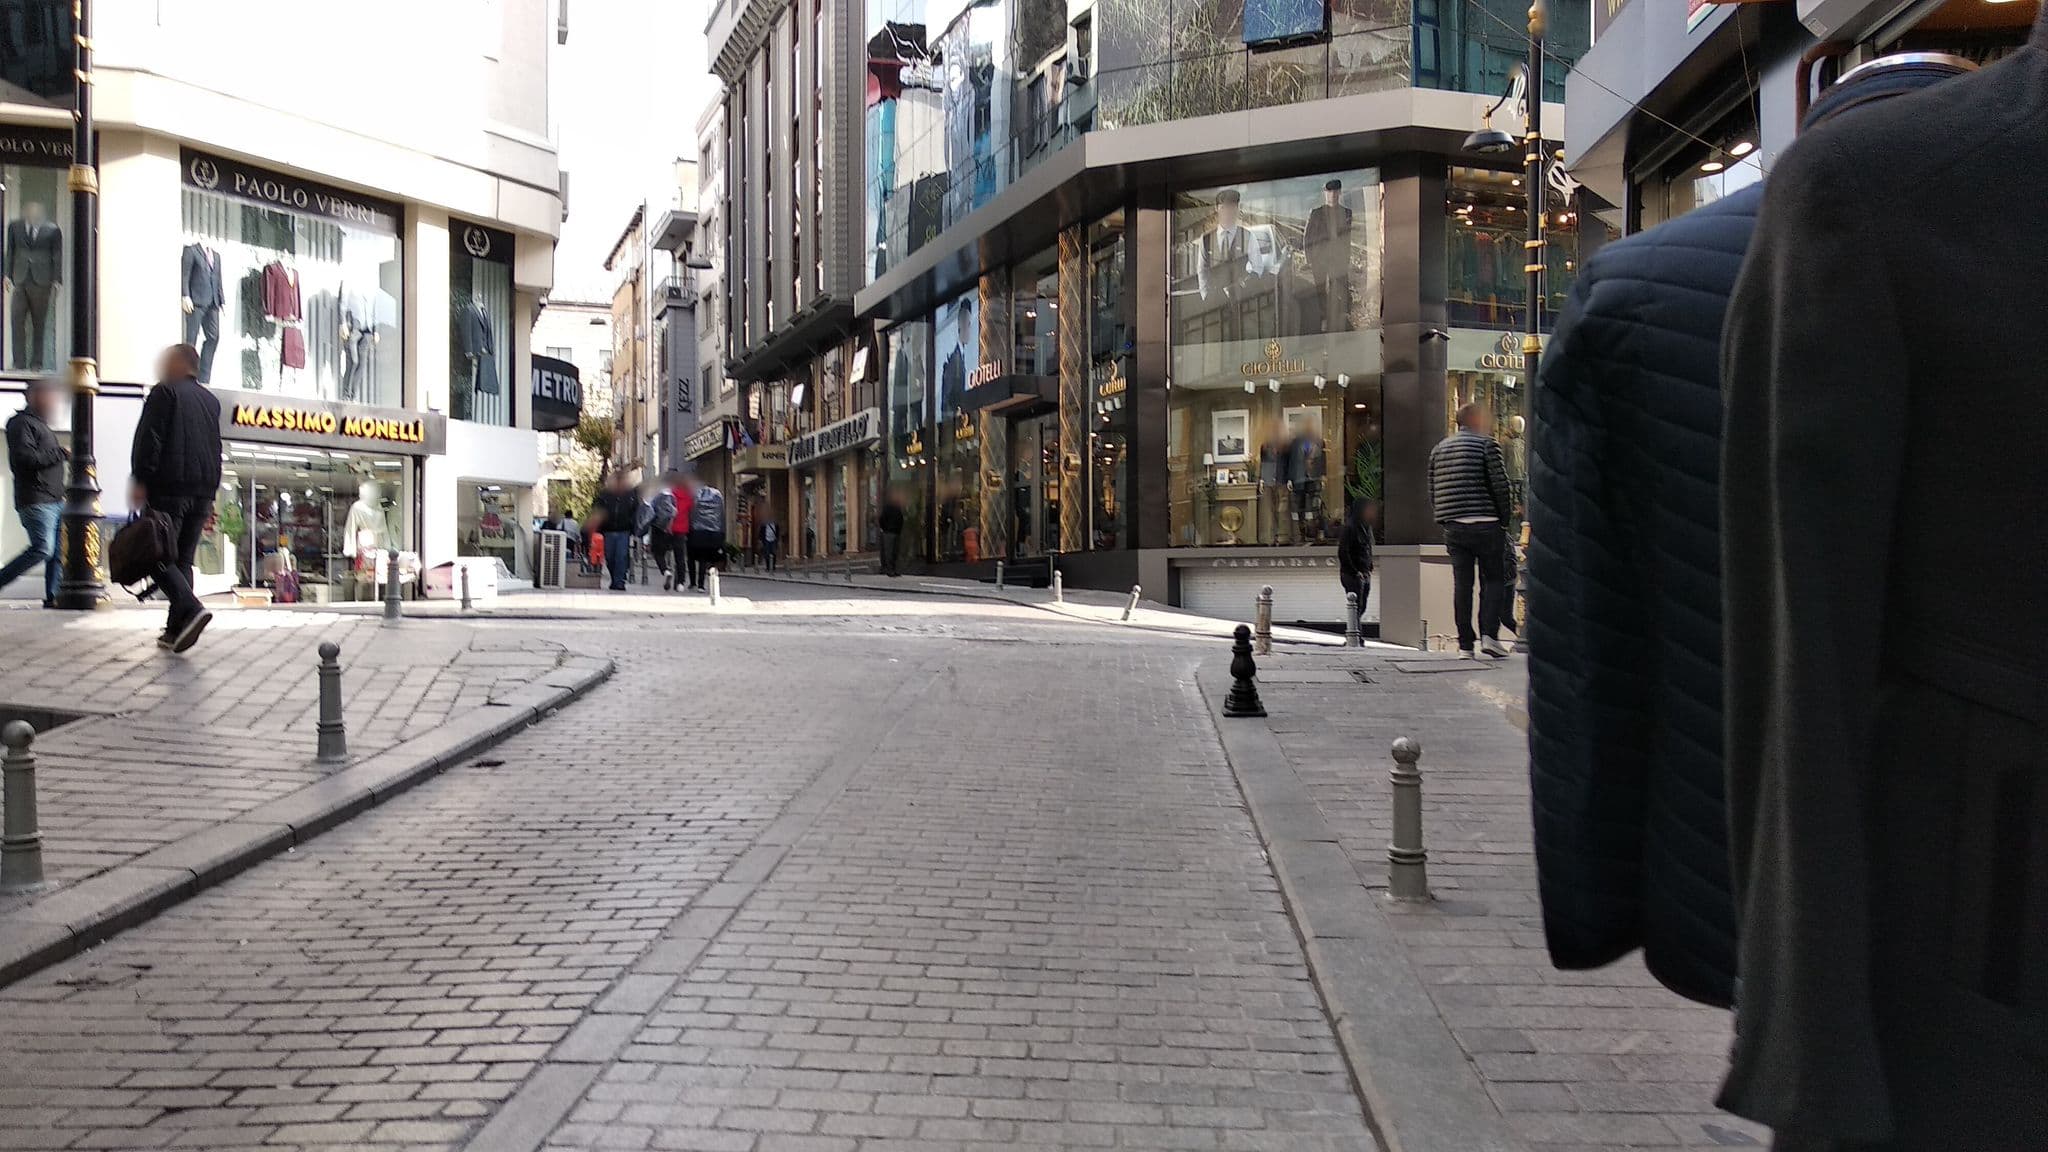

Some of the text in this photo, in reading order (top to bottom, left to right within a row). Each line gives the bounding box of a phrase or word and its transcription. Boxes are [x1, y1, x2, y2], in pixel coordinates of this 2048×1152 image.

[234, 172, 376, 225] PAOLO VERRI
[235, 404, 338, 434] MASSIMO
